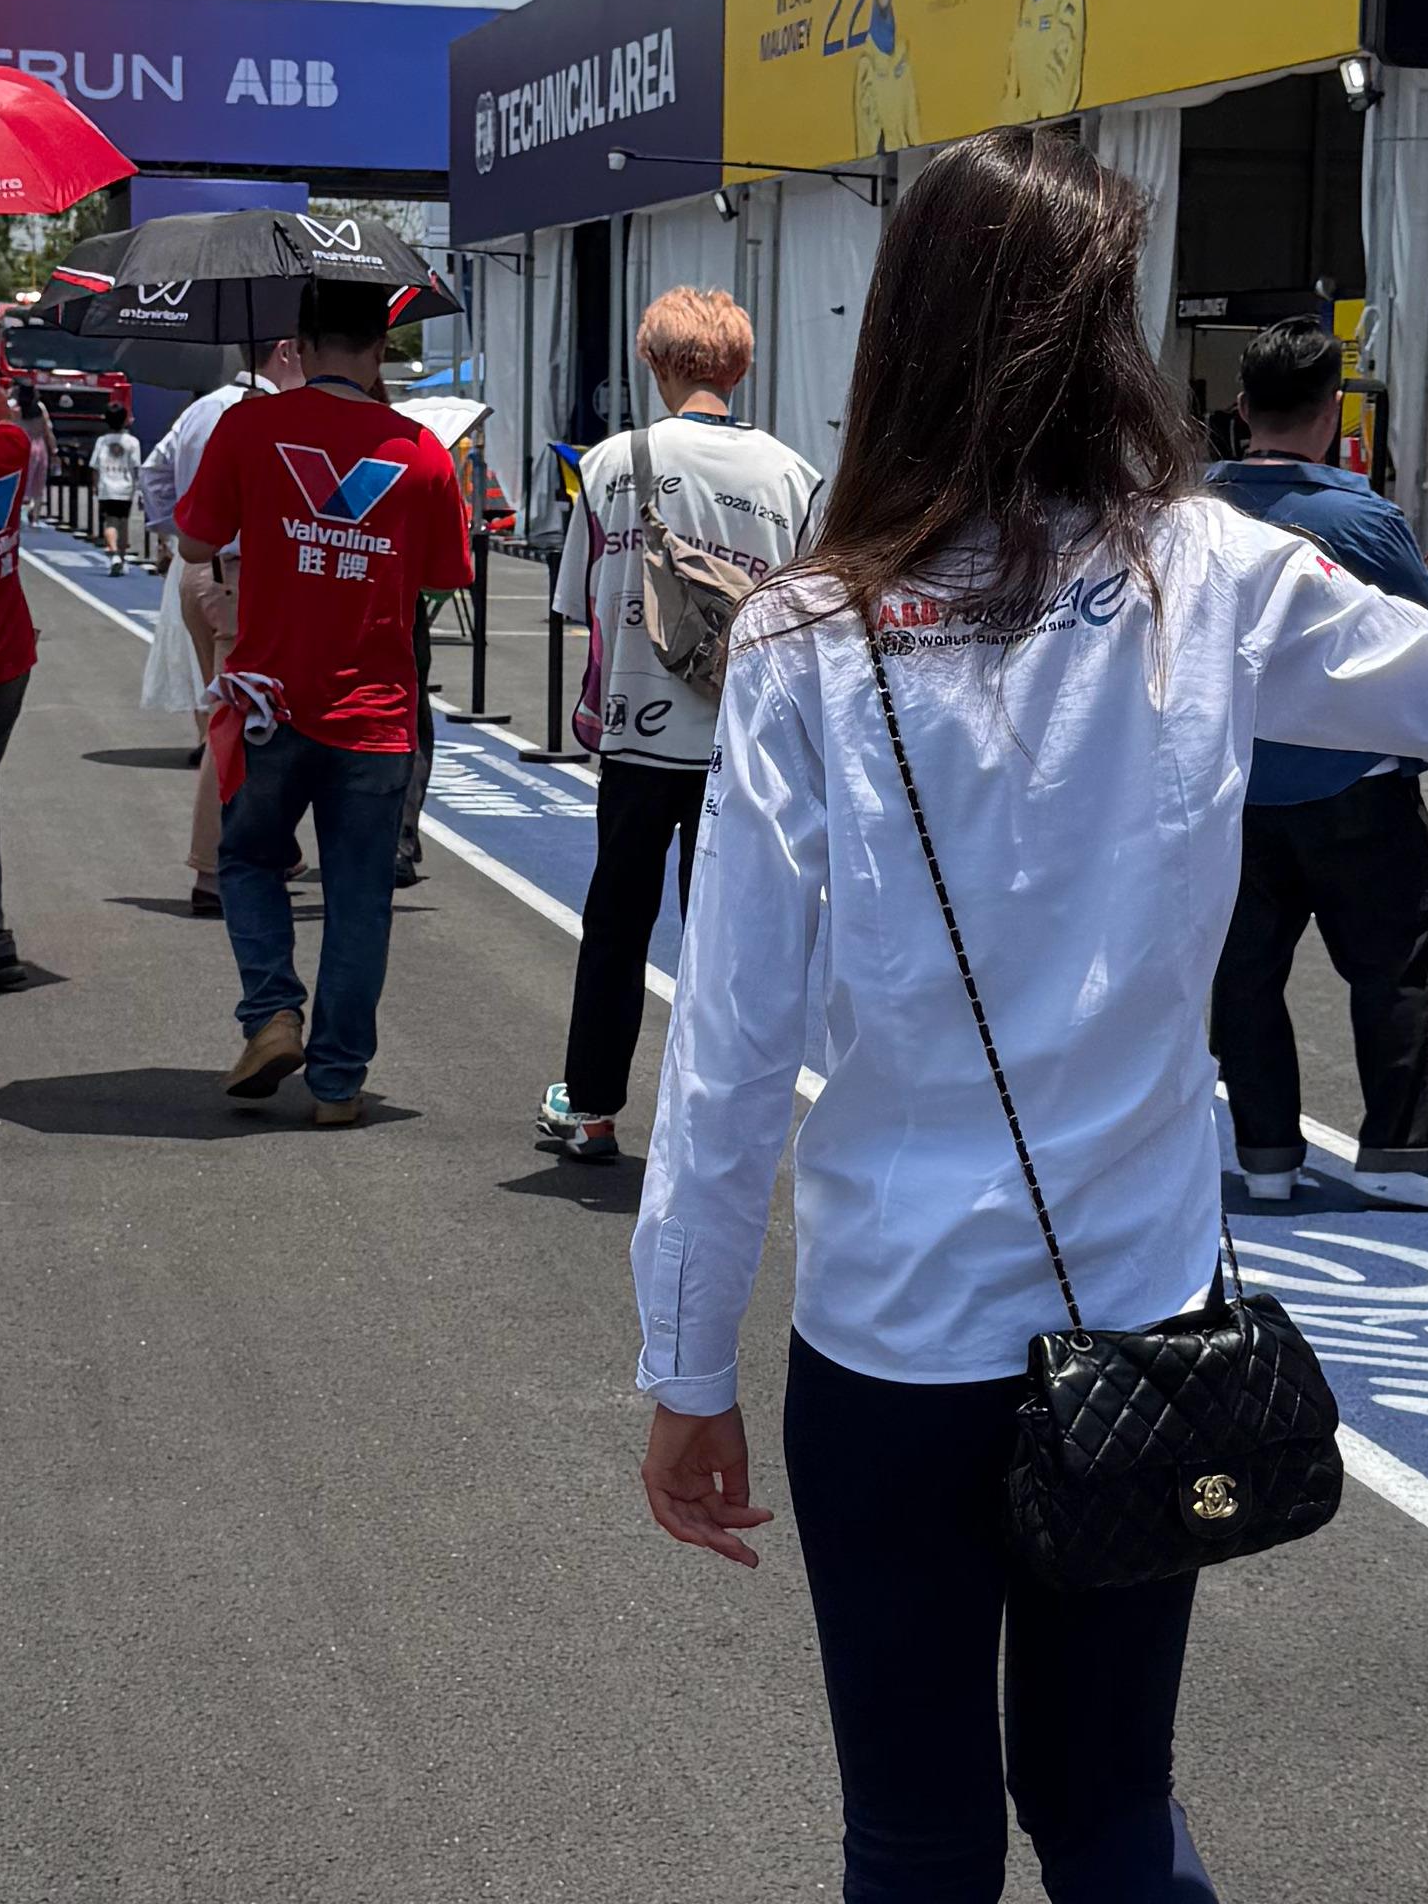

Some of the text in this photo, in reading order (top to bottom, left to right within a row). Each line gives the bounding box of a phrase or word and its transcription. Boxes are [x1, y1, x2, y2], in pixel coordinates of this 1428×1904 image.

[225, 57, 339, 108] ABB
[498, 55, 606, 159] TECHNICAL
[607, 27, 676, 124] AREA
[281, 516, 391, 555] Valvoline
